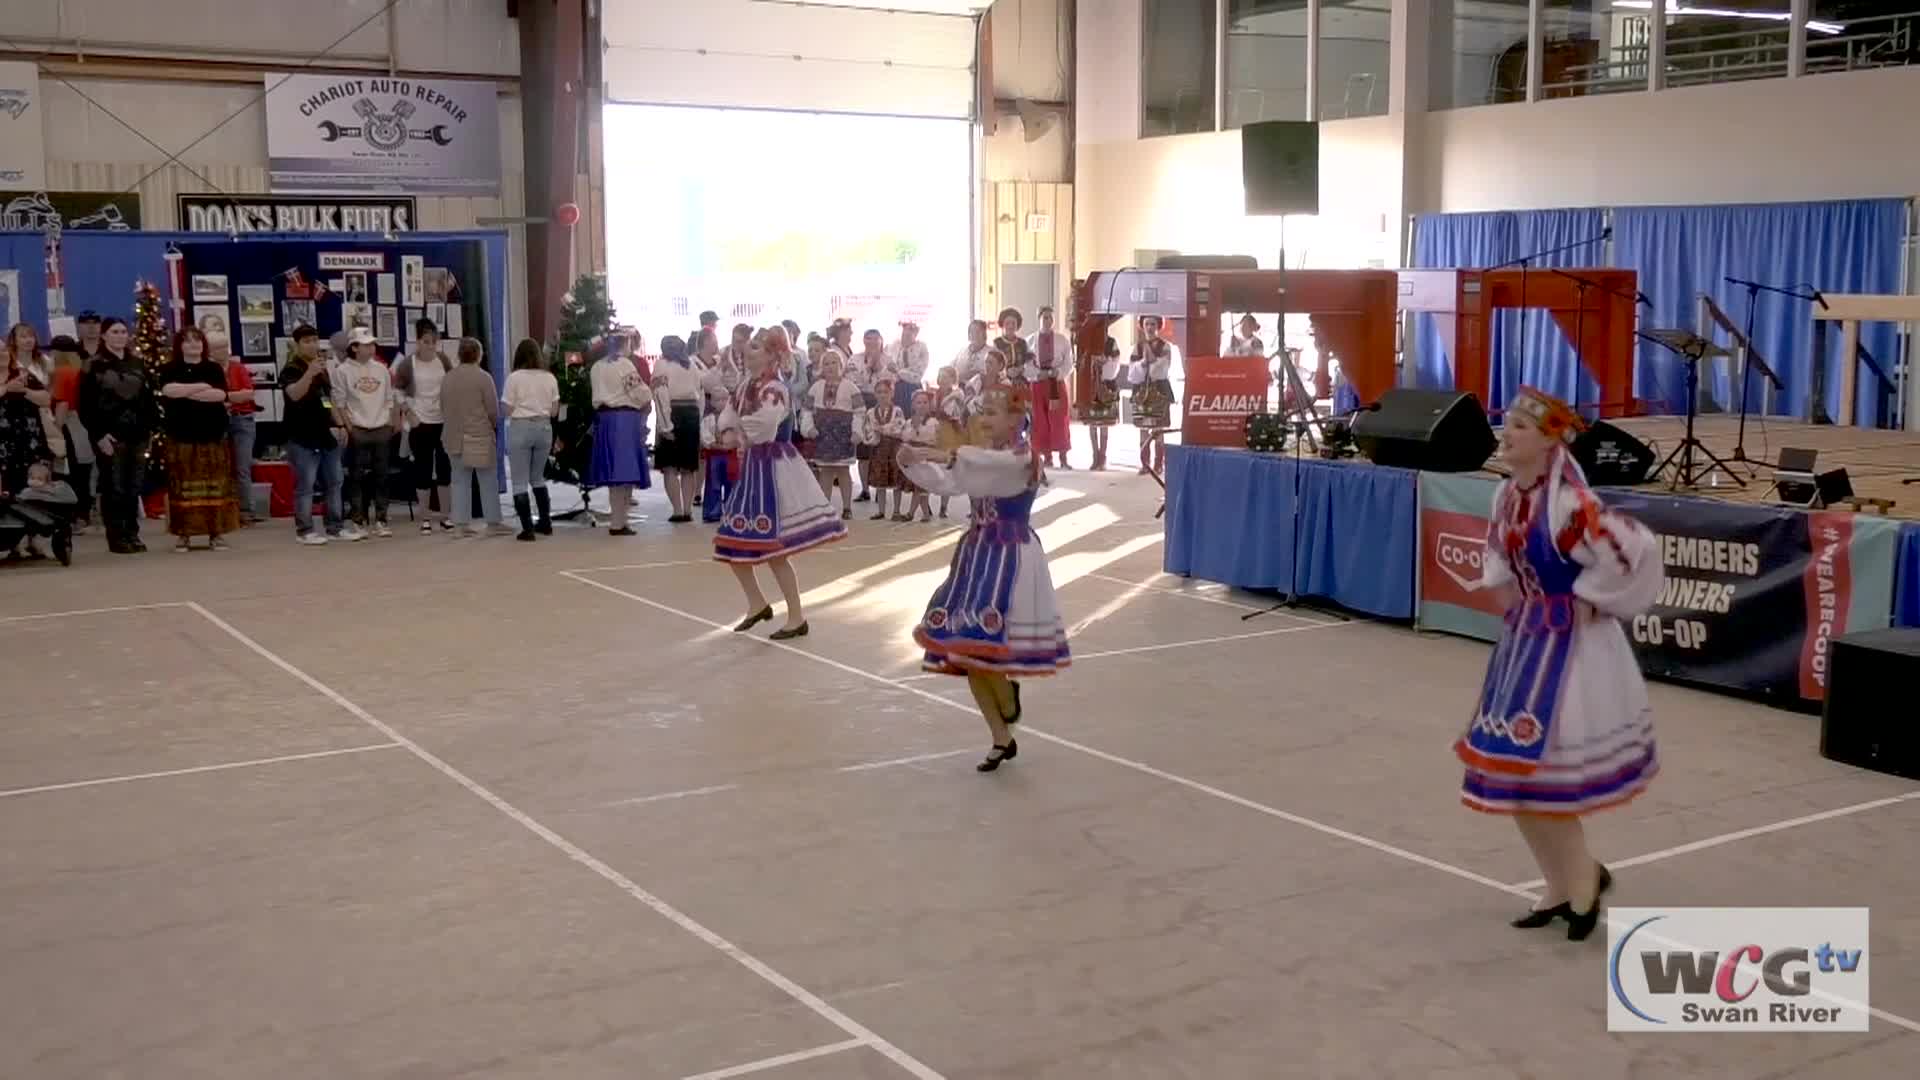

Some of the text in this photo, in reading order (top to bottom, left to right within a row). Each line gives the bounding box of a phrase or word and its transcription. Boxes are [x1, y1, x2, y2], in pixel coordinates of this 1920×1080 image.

[299, 80, 468, 124] CHARIOT AUTO REPAIR
[275, 205, 338, 231] BULK
[323, 256, 378, 266] DENMARK
[1189, 394, 1262, 411] FLAMAN
[1655, 576, 1736, 614] WNERS
[1632, 614, 1707, 650] CO-OP
